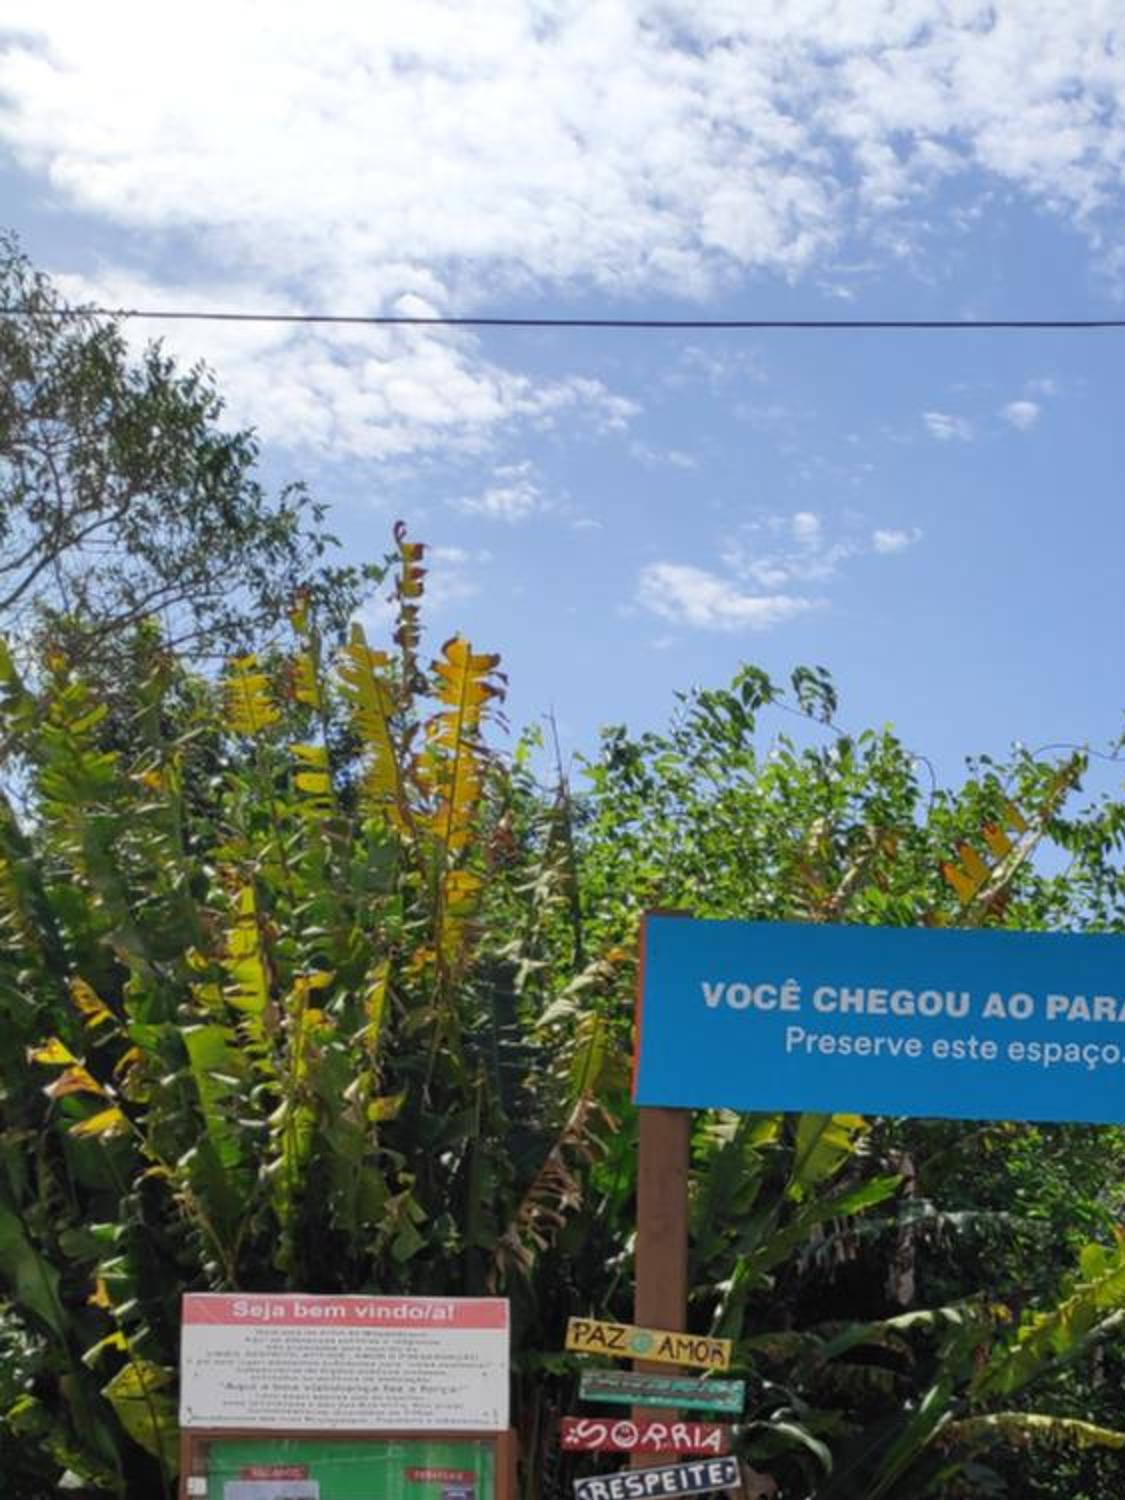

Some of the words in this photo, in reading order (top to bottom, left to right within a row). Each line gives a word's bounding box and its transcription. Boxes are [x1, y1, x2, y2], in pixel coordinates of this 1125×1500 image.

[701, 979, 802, 1012] VOCÊ
[813, 986, 970, 1018] CHEGOU
[982, 992, 1035, 1020] AO
[785, 1026, 923, 1057] Preserve
[932, 1034, 998, 1059] este
[232, 1300, 286, 1321] Seja
[293, 1301, 347, 1319] bem
[571, 1321, 627, 1352] PAZ
[656, 1335, 726, 1367] AMOR
